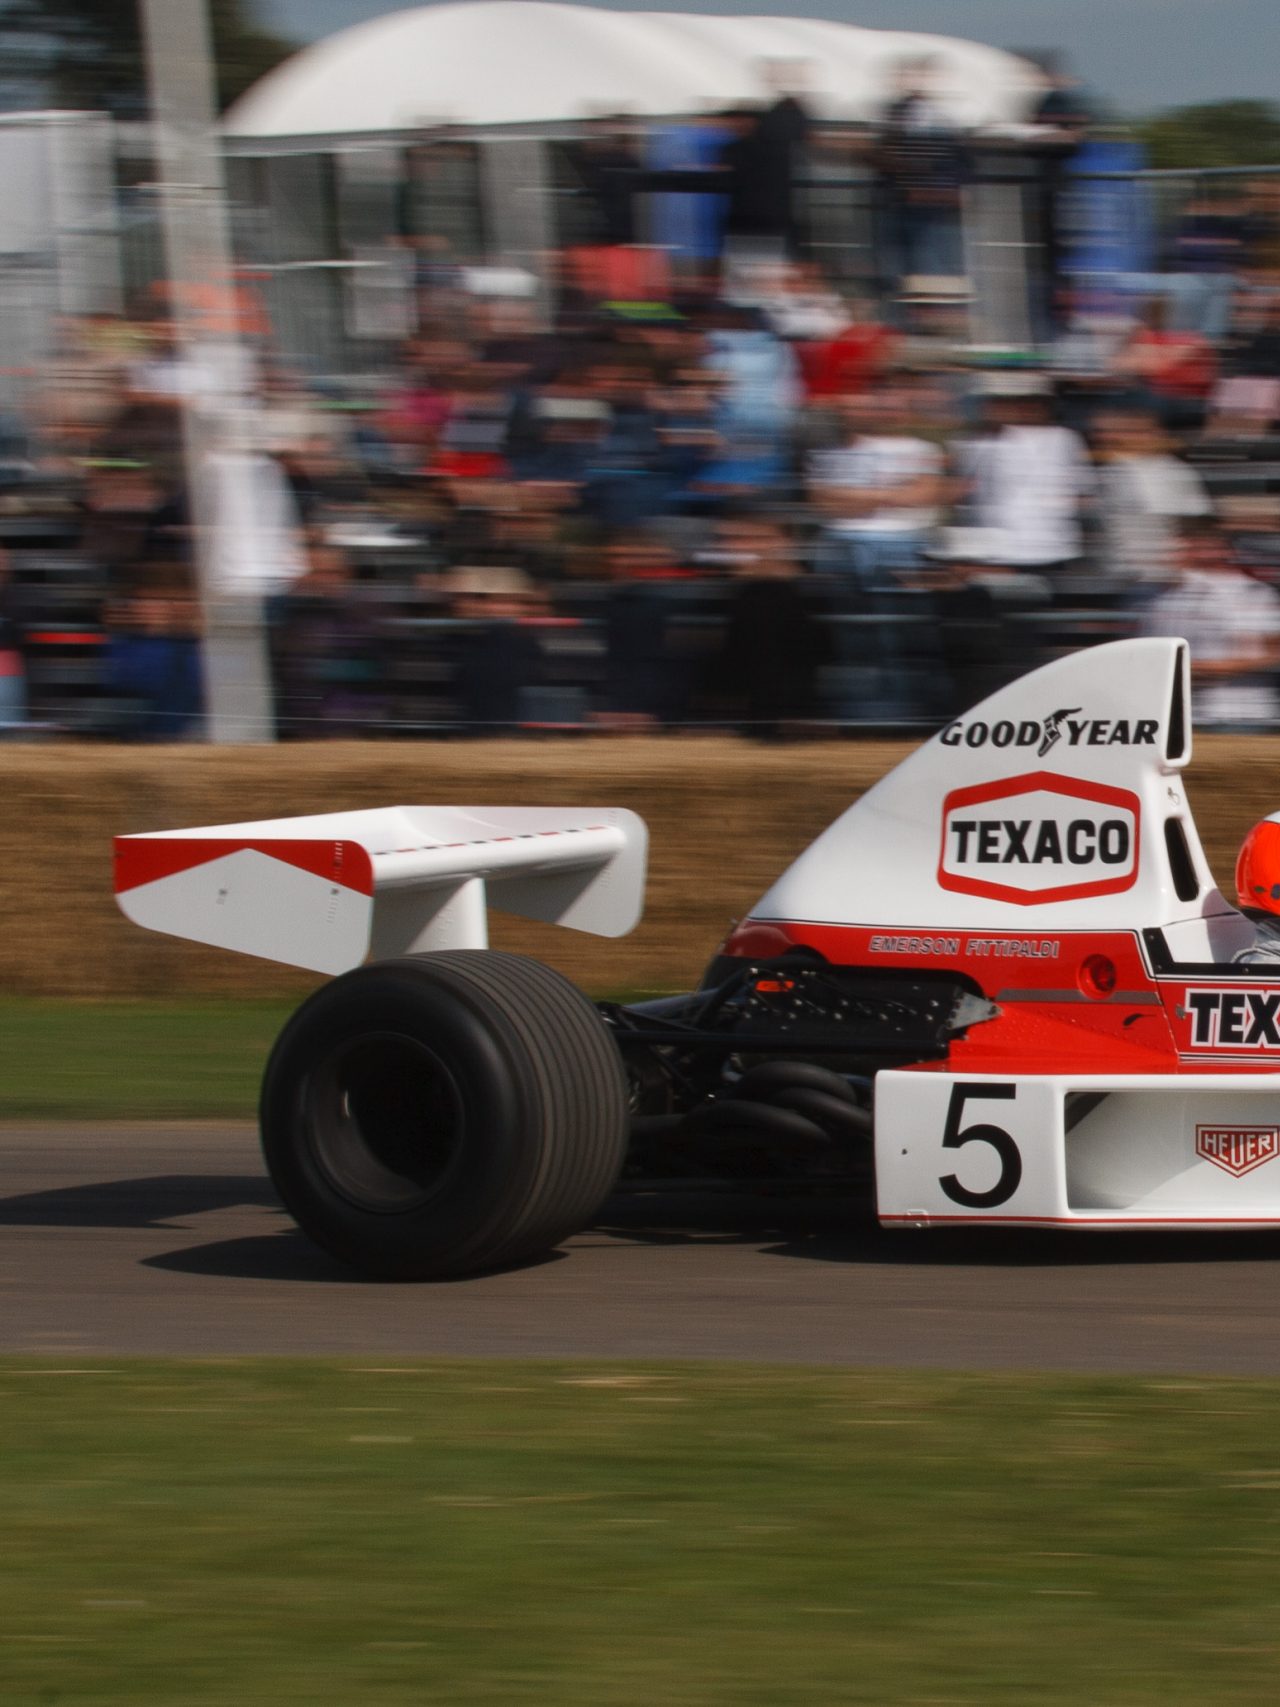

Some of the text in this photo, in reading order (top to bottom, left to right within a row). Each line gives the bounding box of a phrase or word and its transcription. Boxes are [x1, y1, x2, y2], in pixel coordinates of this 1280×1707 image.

[951, 819, 1129, 865] TEXACO
[869, 935, 1060, 958] EMERSON FITTIPALDI
[938, 1082, 1022, 1209] 5
[1204, 1133, 1272, 1167] HEUER
